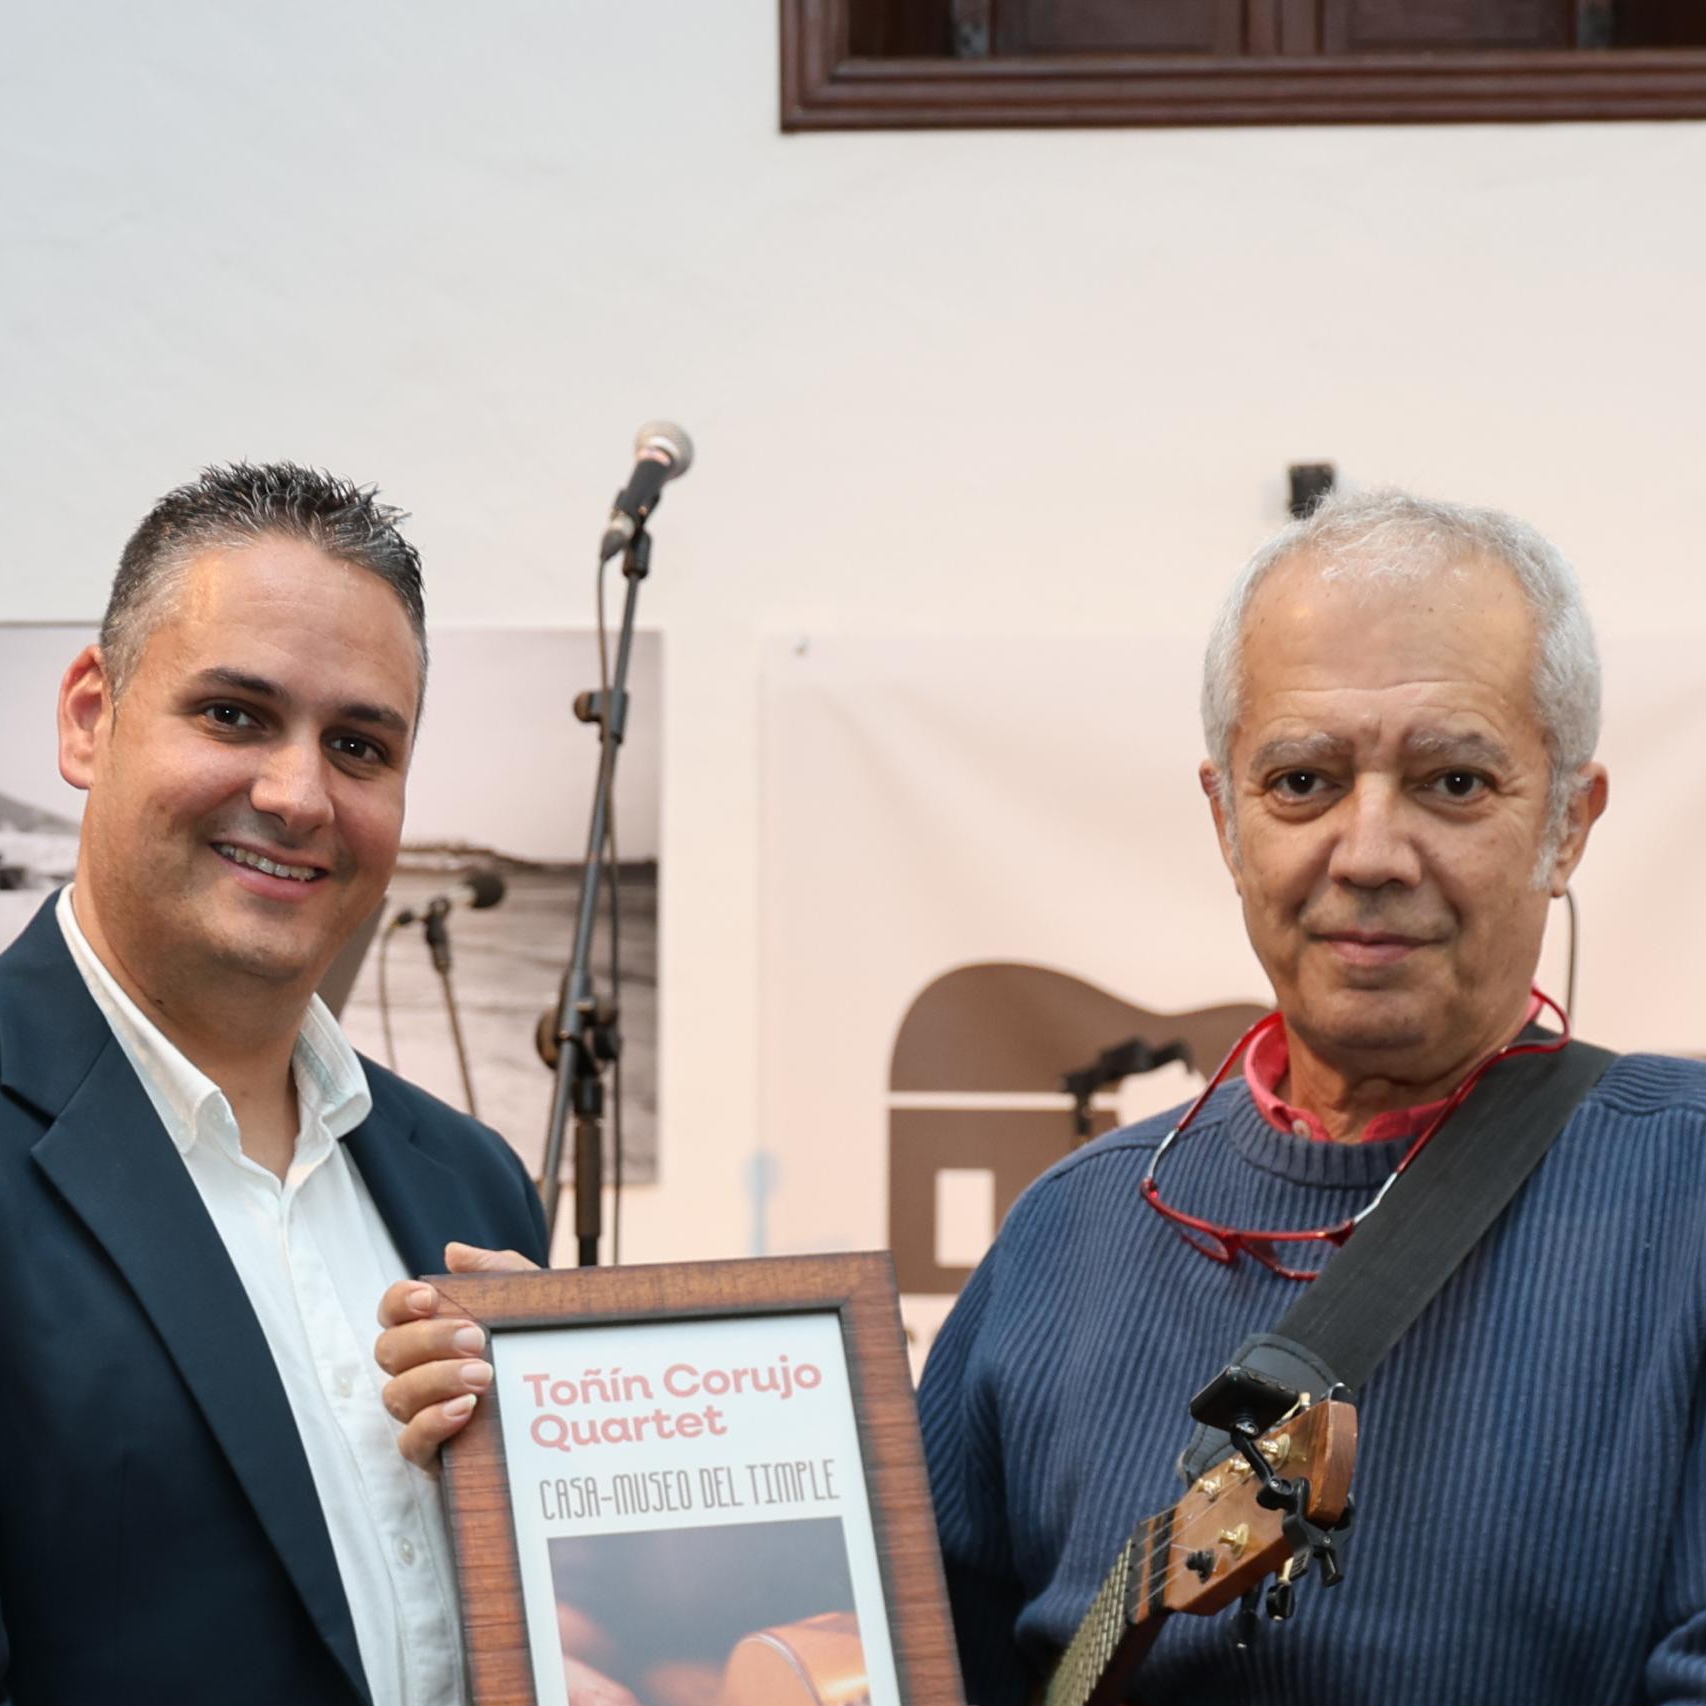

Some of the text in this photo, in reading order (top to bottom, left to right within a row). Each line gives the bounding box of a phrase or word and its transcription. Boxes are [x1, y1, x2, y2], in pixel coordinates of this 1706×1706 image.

[523, 1354, 822, 1408] Toñín Corujo
[530, 1405, 727, 1452] Quartet
[539, 1459, 840, 1520] CASA-MUSEO DEL TIMPLE
